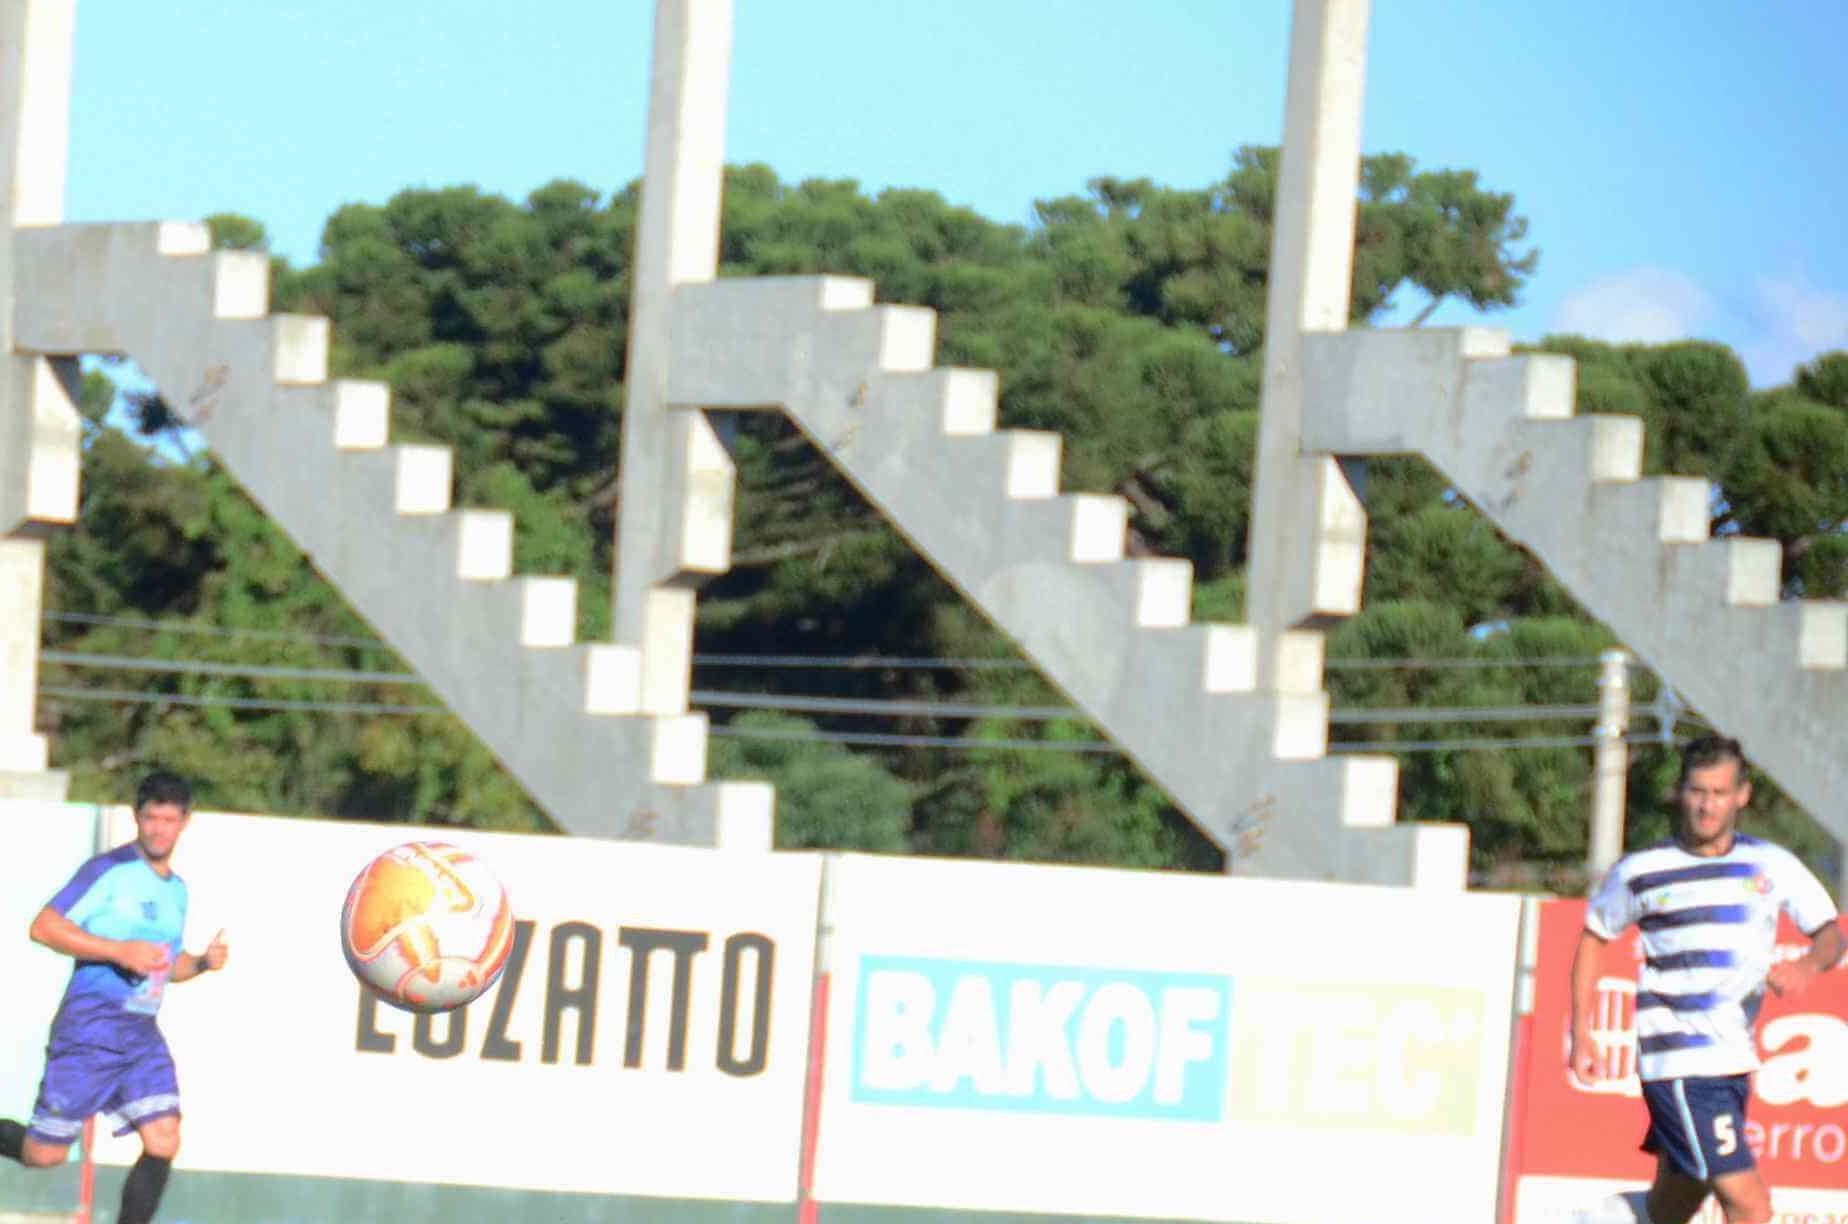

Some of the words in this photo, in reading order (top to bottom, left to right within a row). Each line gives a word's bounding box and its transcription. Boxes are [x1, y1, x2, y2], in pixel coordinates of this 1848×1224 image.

[861, 970, 1219, 1105] BAKOF
[1249, 992, 1440, 1117] TEC
[1713, 1115, 1736, 1156] 5
